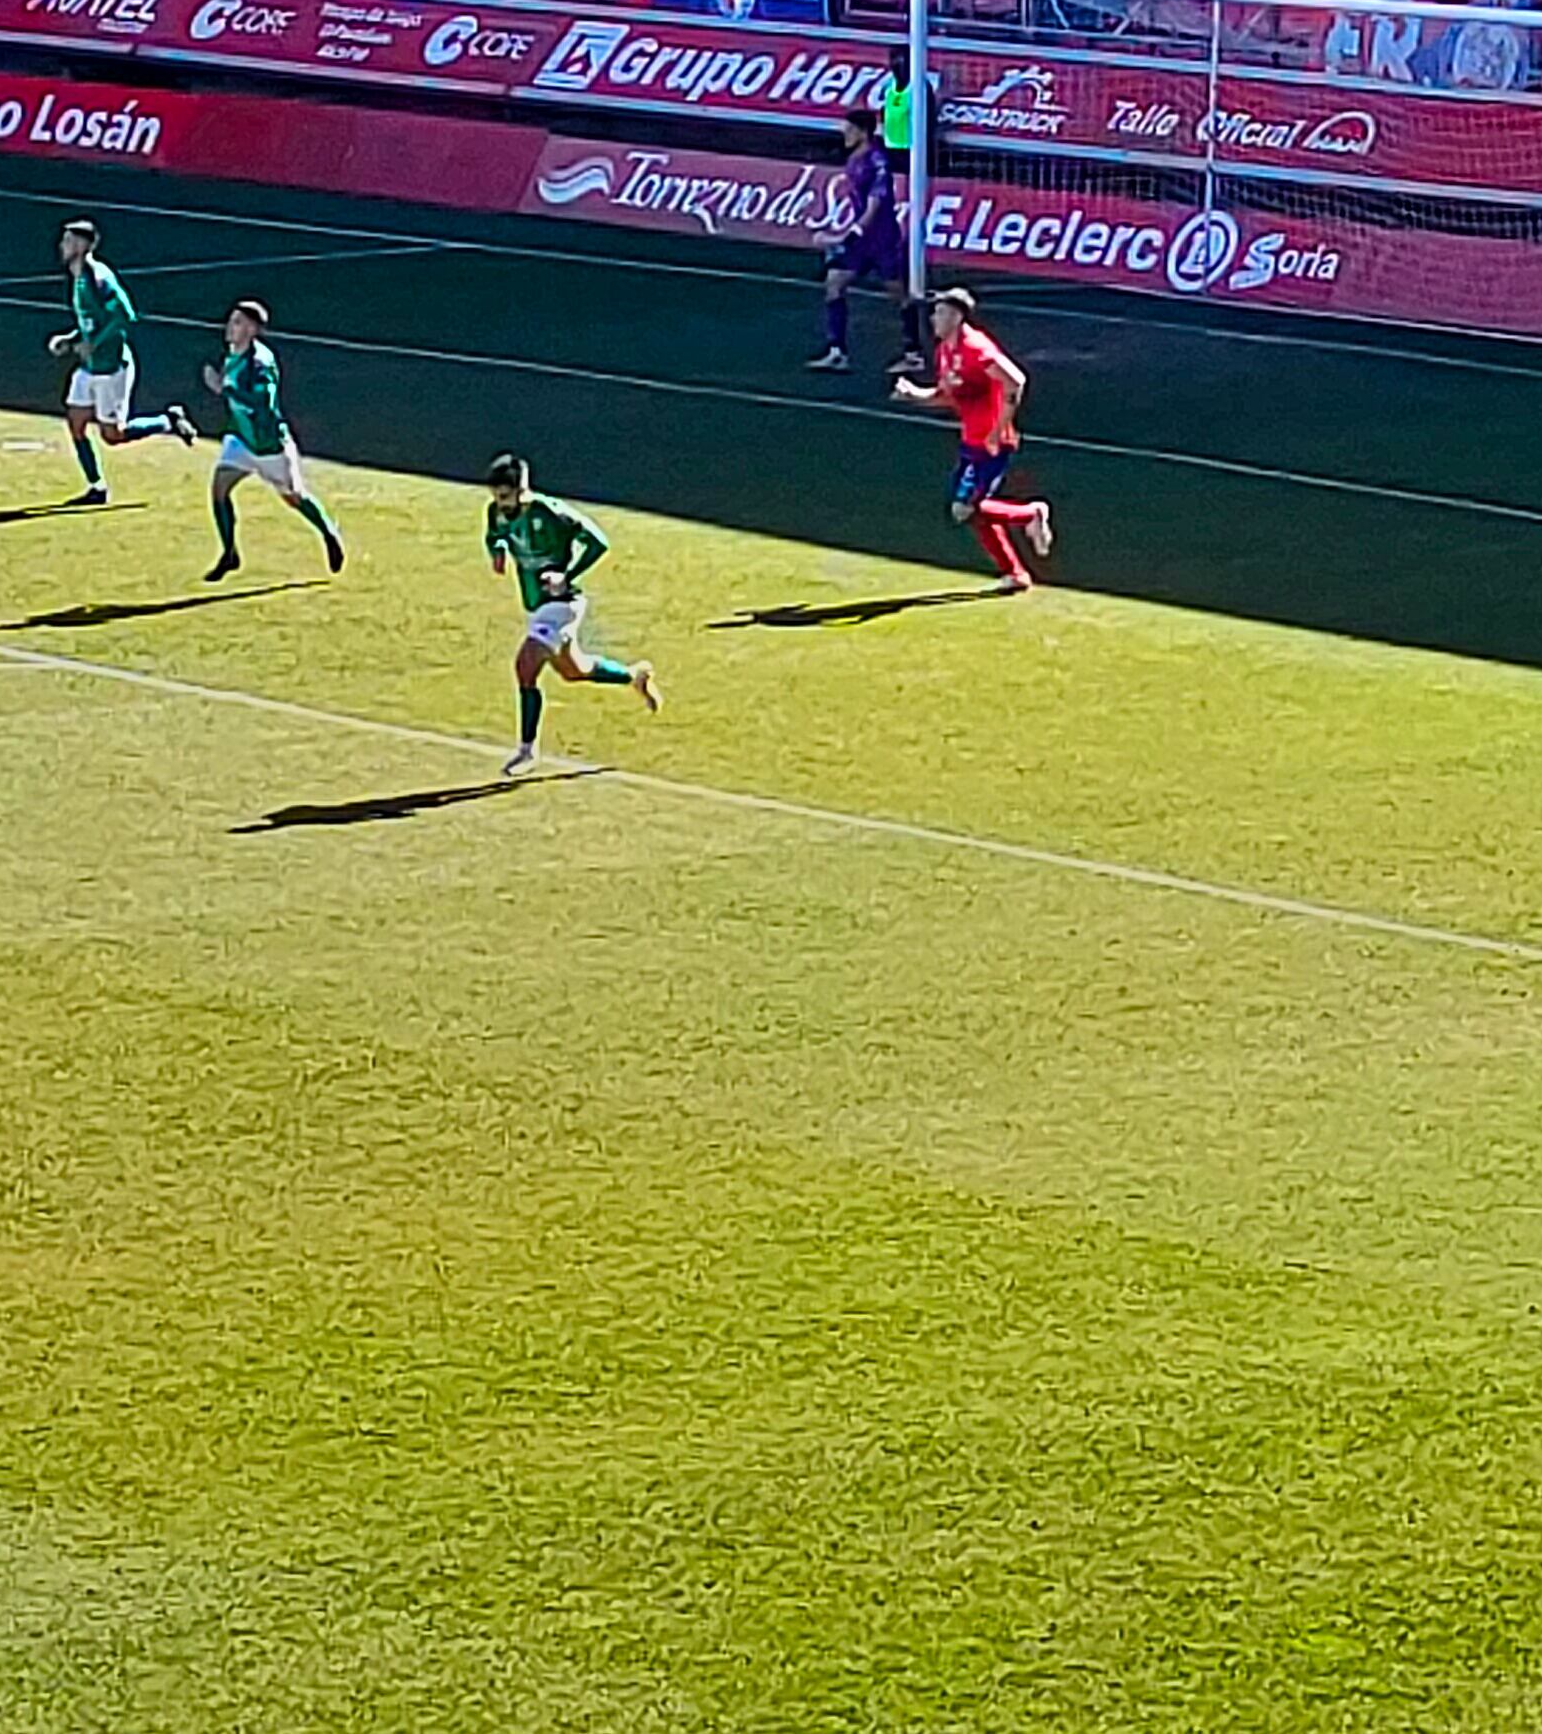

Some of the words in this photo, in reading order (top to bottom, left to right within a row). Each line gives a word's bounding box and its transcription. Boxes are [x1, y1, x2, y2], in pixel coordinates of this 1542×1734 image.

[609, 37, 775, 101] Grupo
[767, 51, 941, 110] Herc
[30, 96, 160, 153] Losán
[611, 151, 767, 234] Torrezno
[764, 164, 816, 226] de
[925, 195, 1165, 272] E.Leclerc
